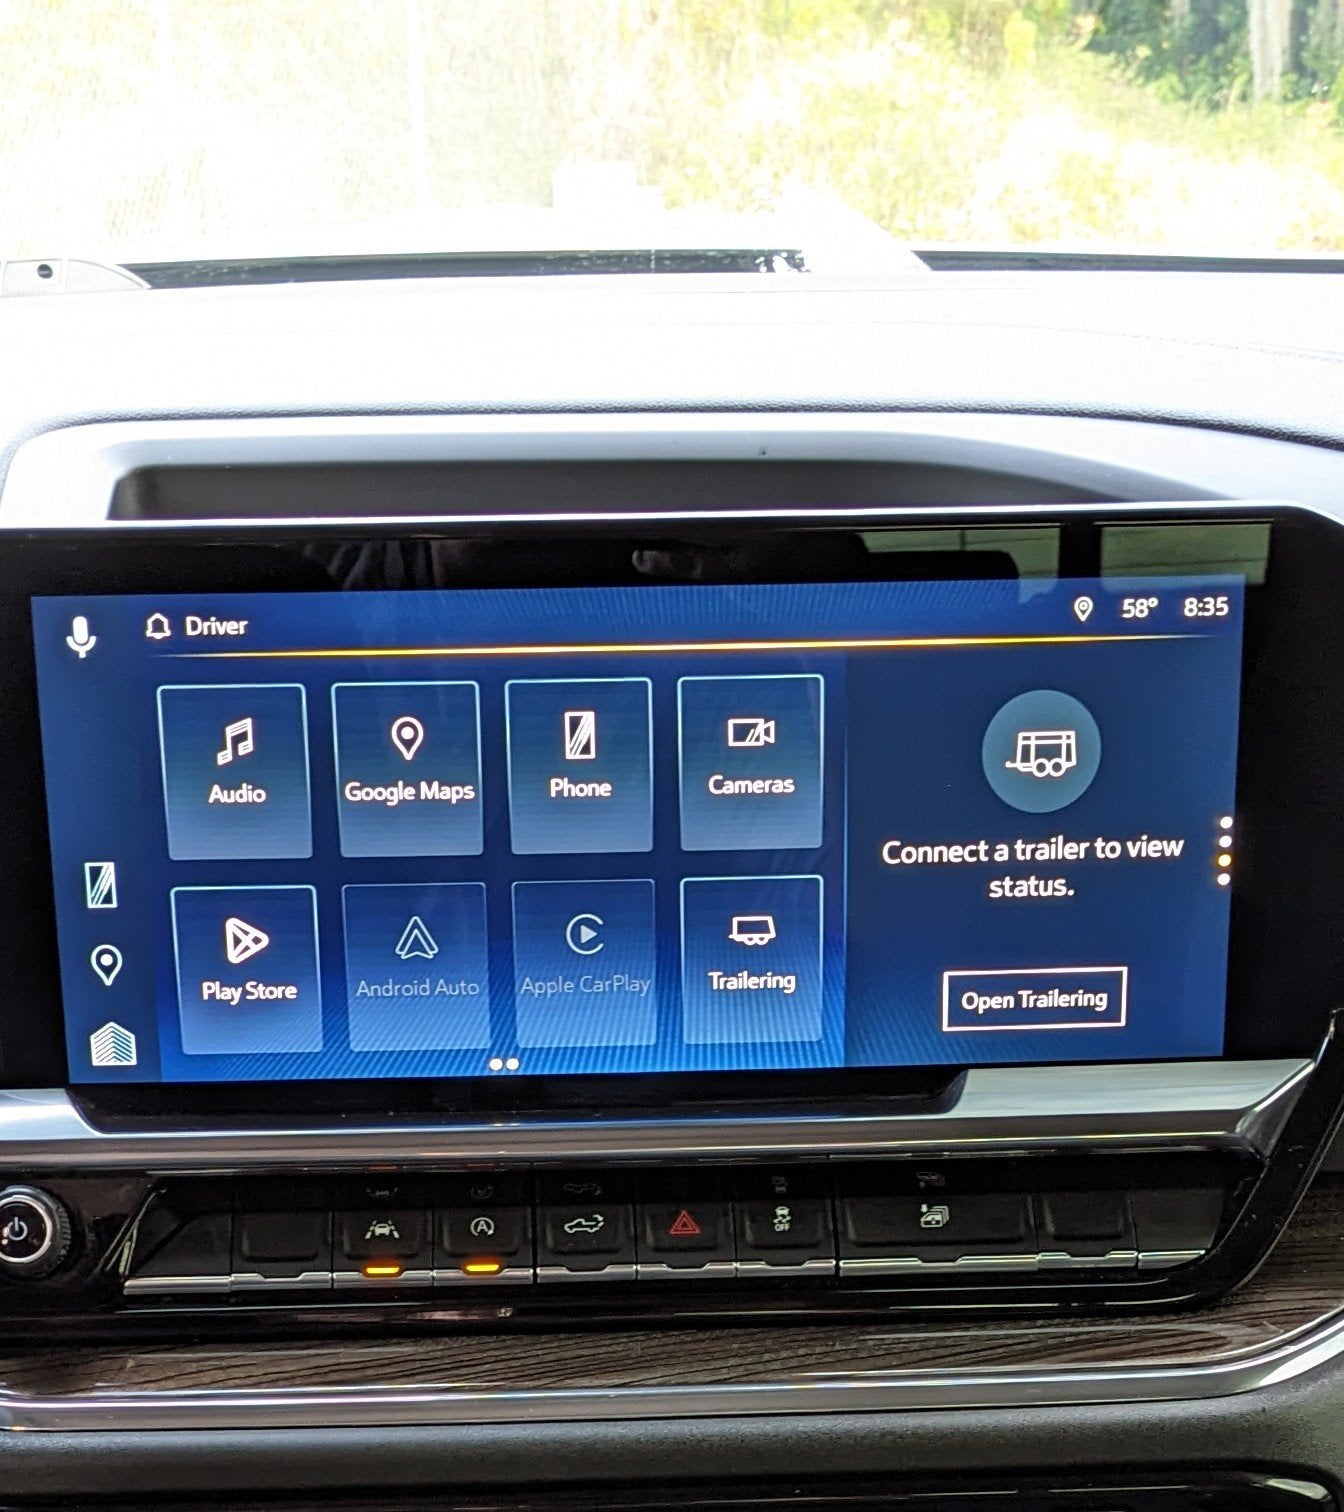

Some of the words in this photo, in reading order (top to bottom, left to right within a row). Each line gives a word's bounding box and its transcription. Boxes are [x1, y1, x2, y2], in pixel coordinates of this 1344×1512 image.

[1183, 595, 1229, 617] 8:35
[185, 615, 249, 636] Driver
[208, 782, 267, 804] Audio
[344, 779, 416, 806] Google
[419, 778, 476, 803] Maps
[549, 777, 612, 798] Phone
[708, 774, 795, 795] Cameras
[882, 838, 989, 865] Connect
[993, 843, 1009, 862] a
[1014, 834, 1091, 861] trailer
[1093, 836, 1122, 859] to
[1126, 833, 1185, 858] view
[989, 874, 1075, 898] status.
[202, 979, 242, 1003] Play
[245, 979, 298, 1000] Store
[356, 977, 431, 997] Android
[435, 977, 480, 996] Auto
[520, 975, 575, 999] Apple
[578, 972, 652, 996] CarPlay
[707, 970, 796, 994] Trailering
[961, 991, 1015, 1013] Open
[1018, 987, 1108, 1012] Trailering
[774, 1222, 791, 1232] OFF
